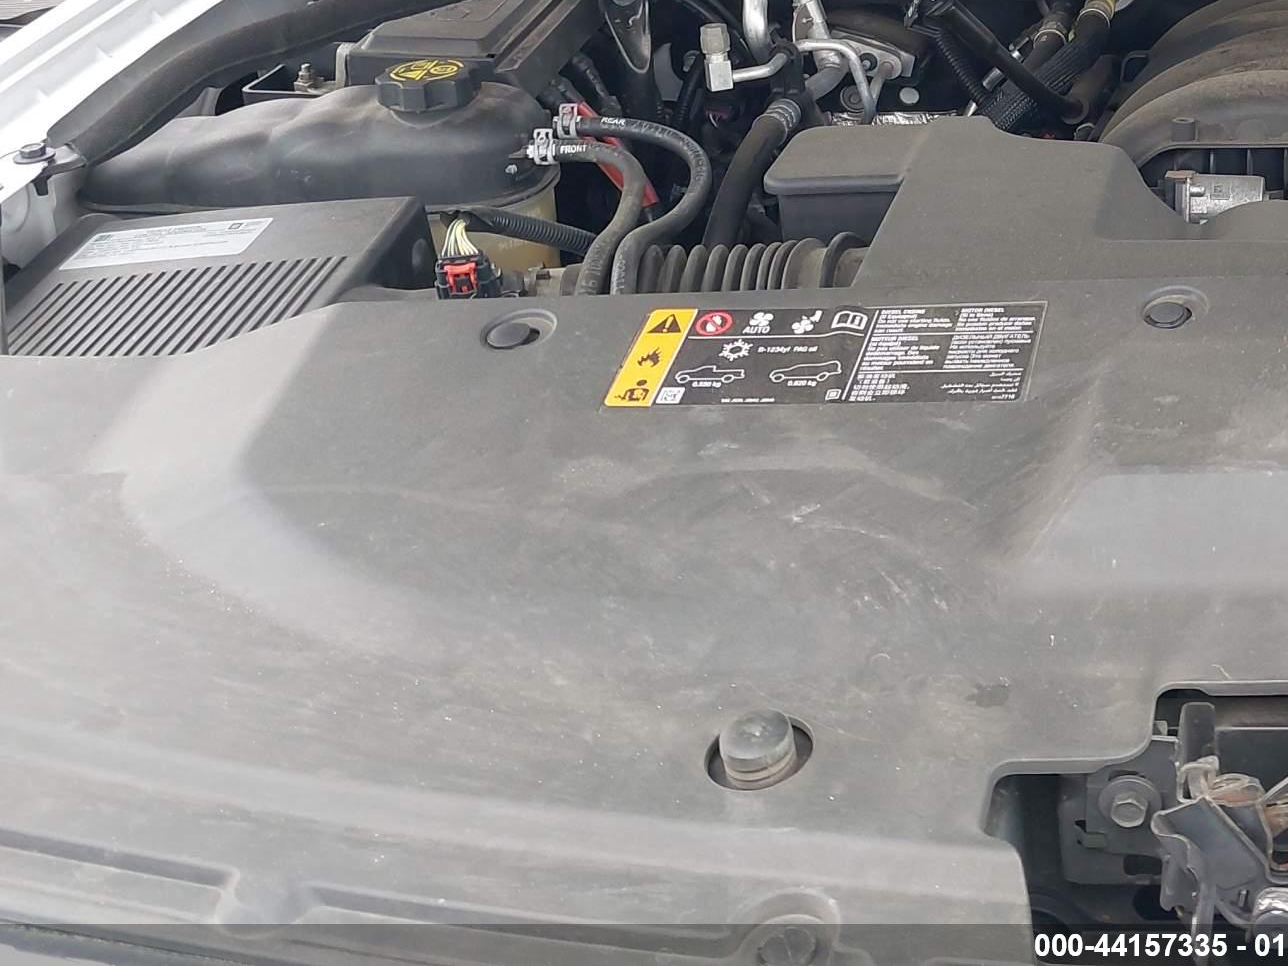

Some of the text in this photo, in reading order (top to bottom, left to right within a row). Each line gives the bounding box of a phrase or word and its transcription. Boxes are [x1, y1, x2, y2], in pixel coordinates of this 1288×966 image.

[601, 117, 626, 125] REAR
[560, 144, 587, 154] FRONT
[743, 326, 771, 334] AUTO
